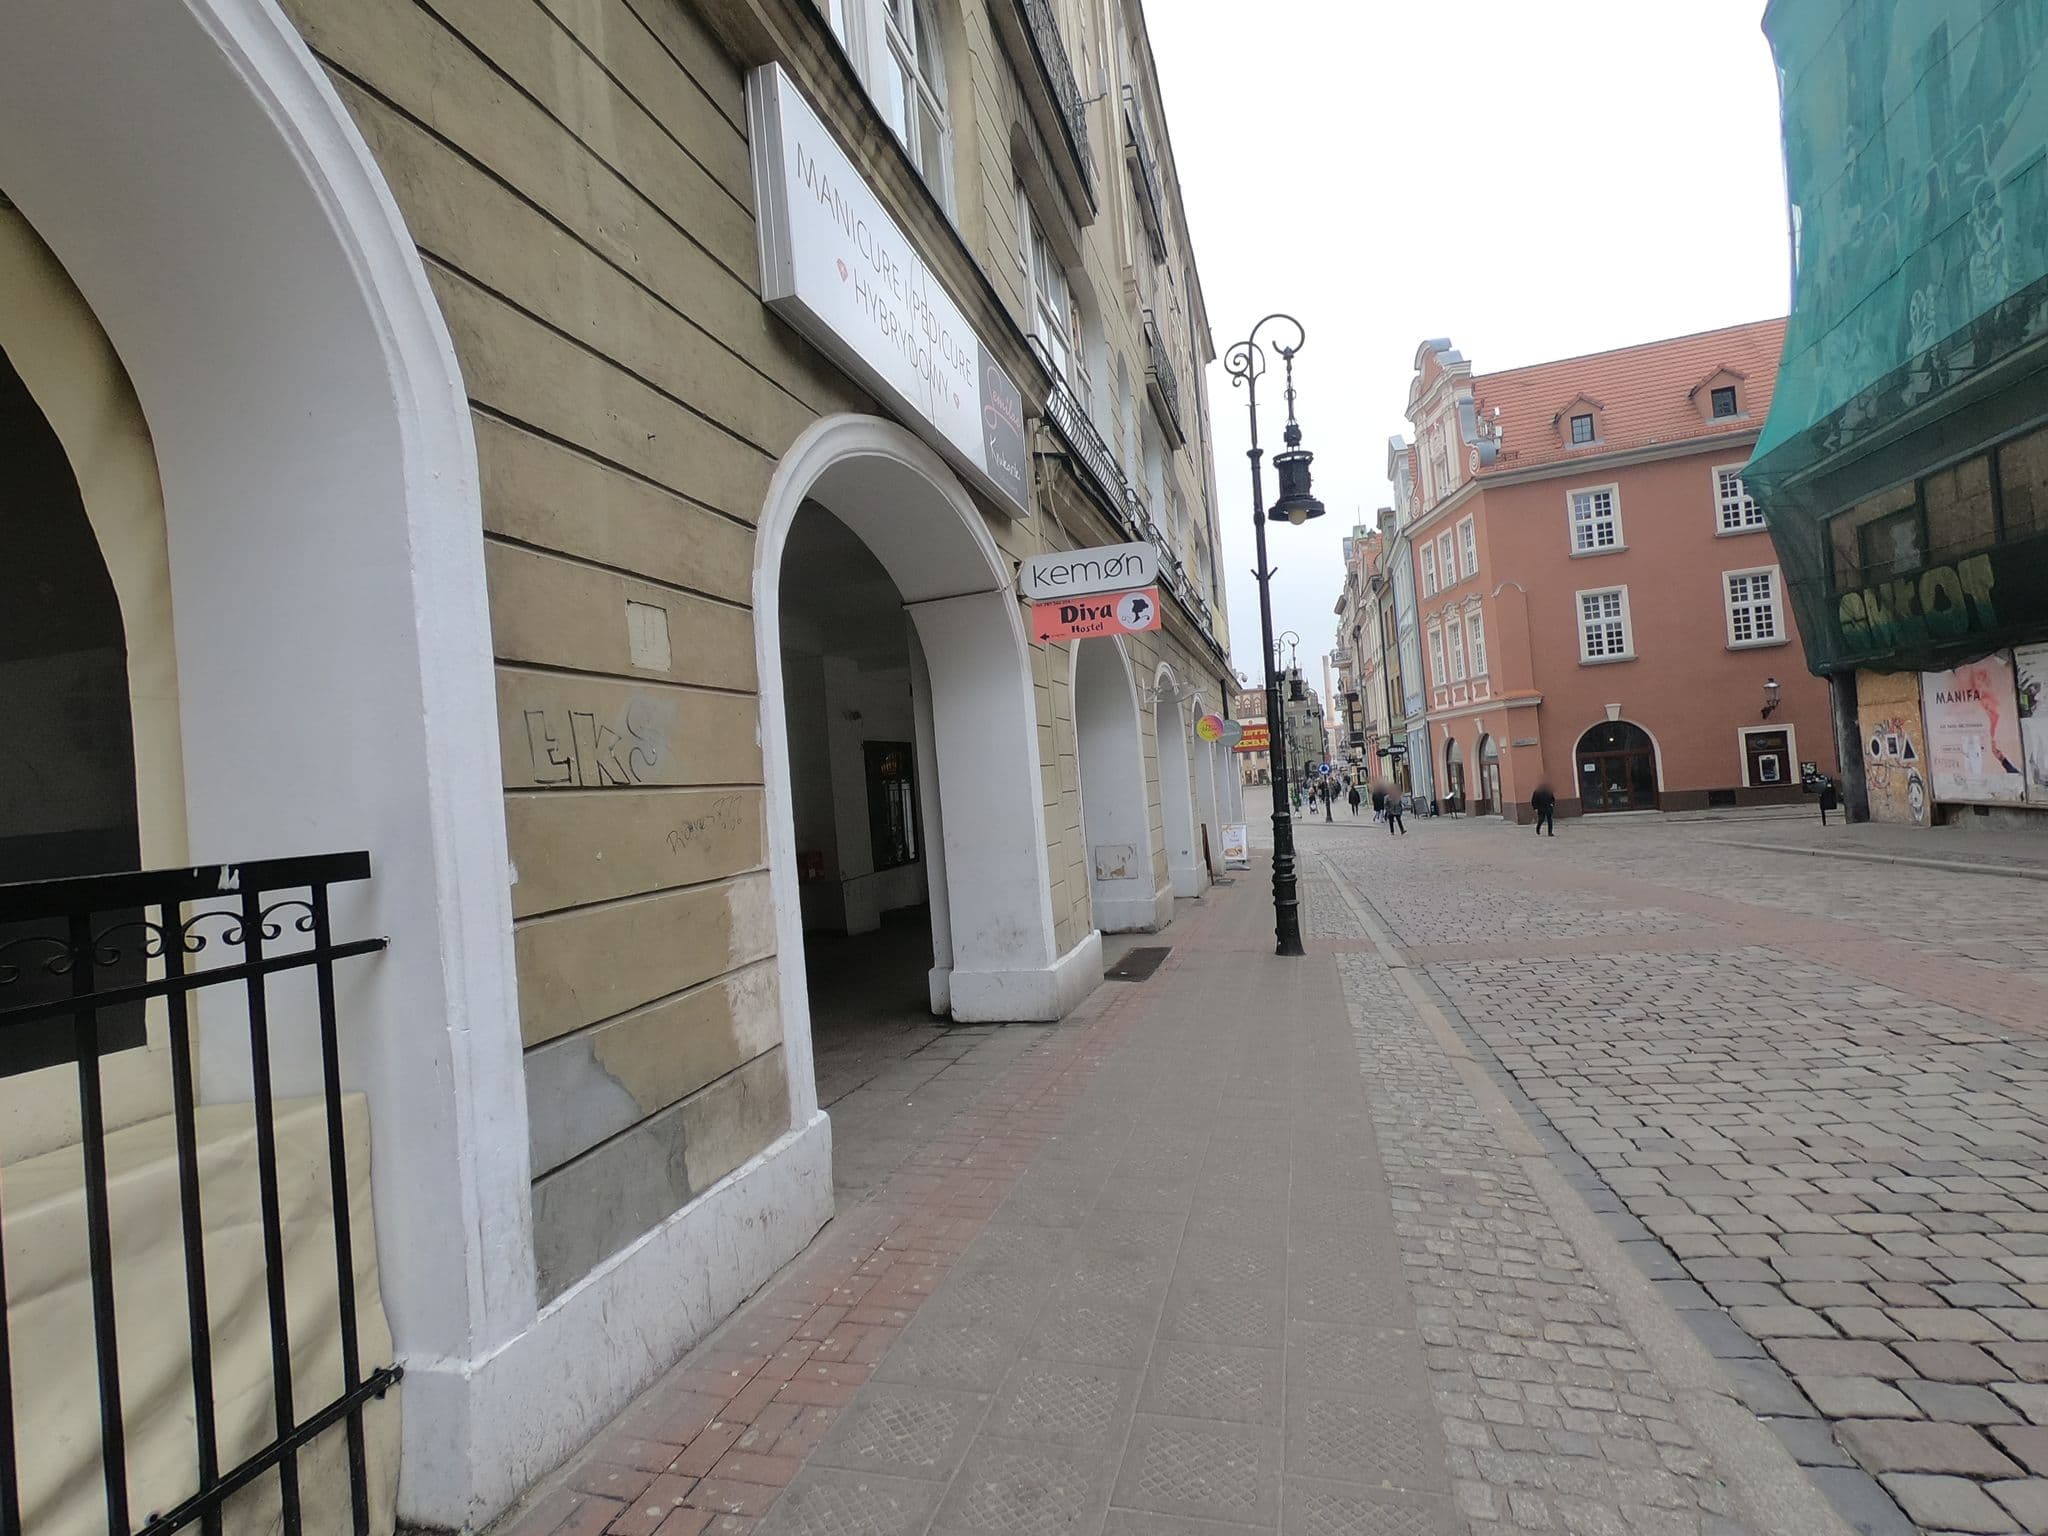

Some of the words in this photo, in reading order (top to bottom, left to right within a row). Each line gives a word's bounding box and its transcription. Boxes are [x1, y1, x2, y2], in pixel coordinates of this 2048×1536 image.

[797, 142, 901, 299] MANICURE
[912, 290, 974, 388] PEDICURE
[853, 268, 949, 404] HYBRYDOWY
[1059, 603, 1113, 624] Diva
[1071, 621, 1104, 633] Hostel
[1936, 689, 1982, 704] MANIFA
